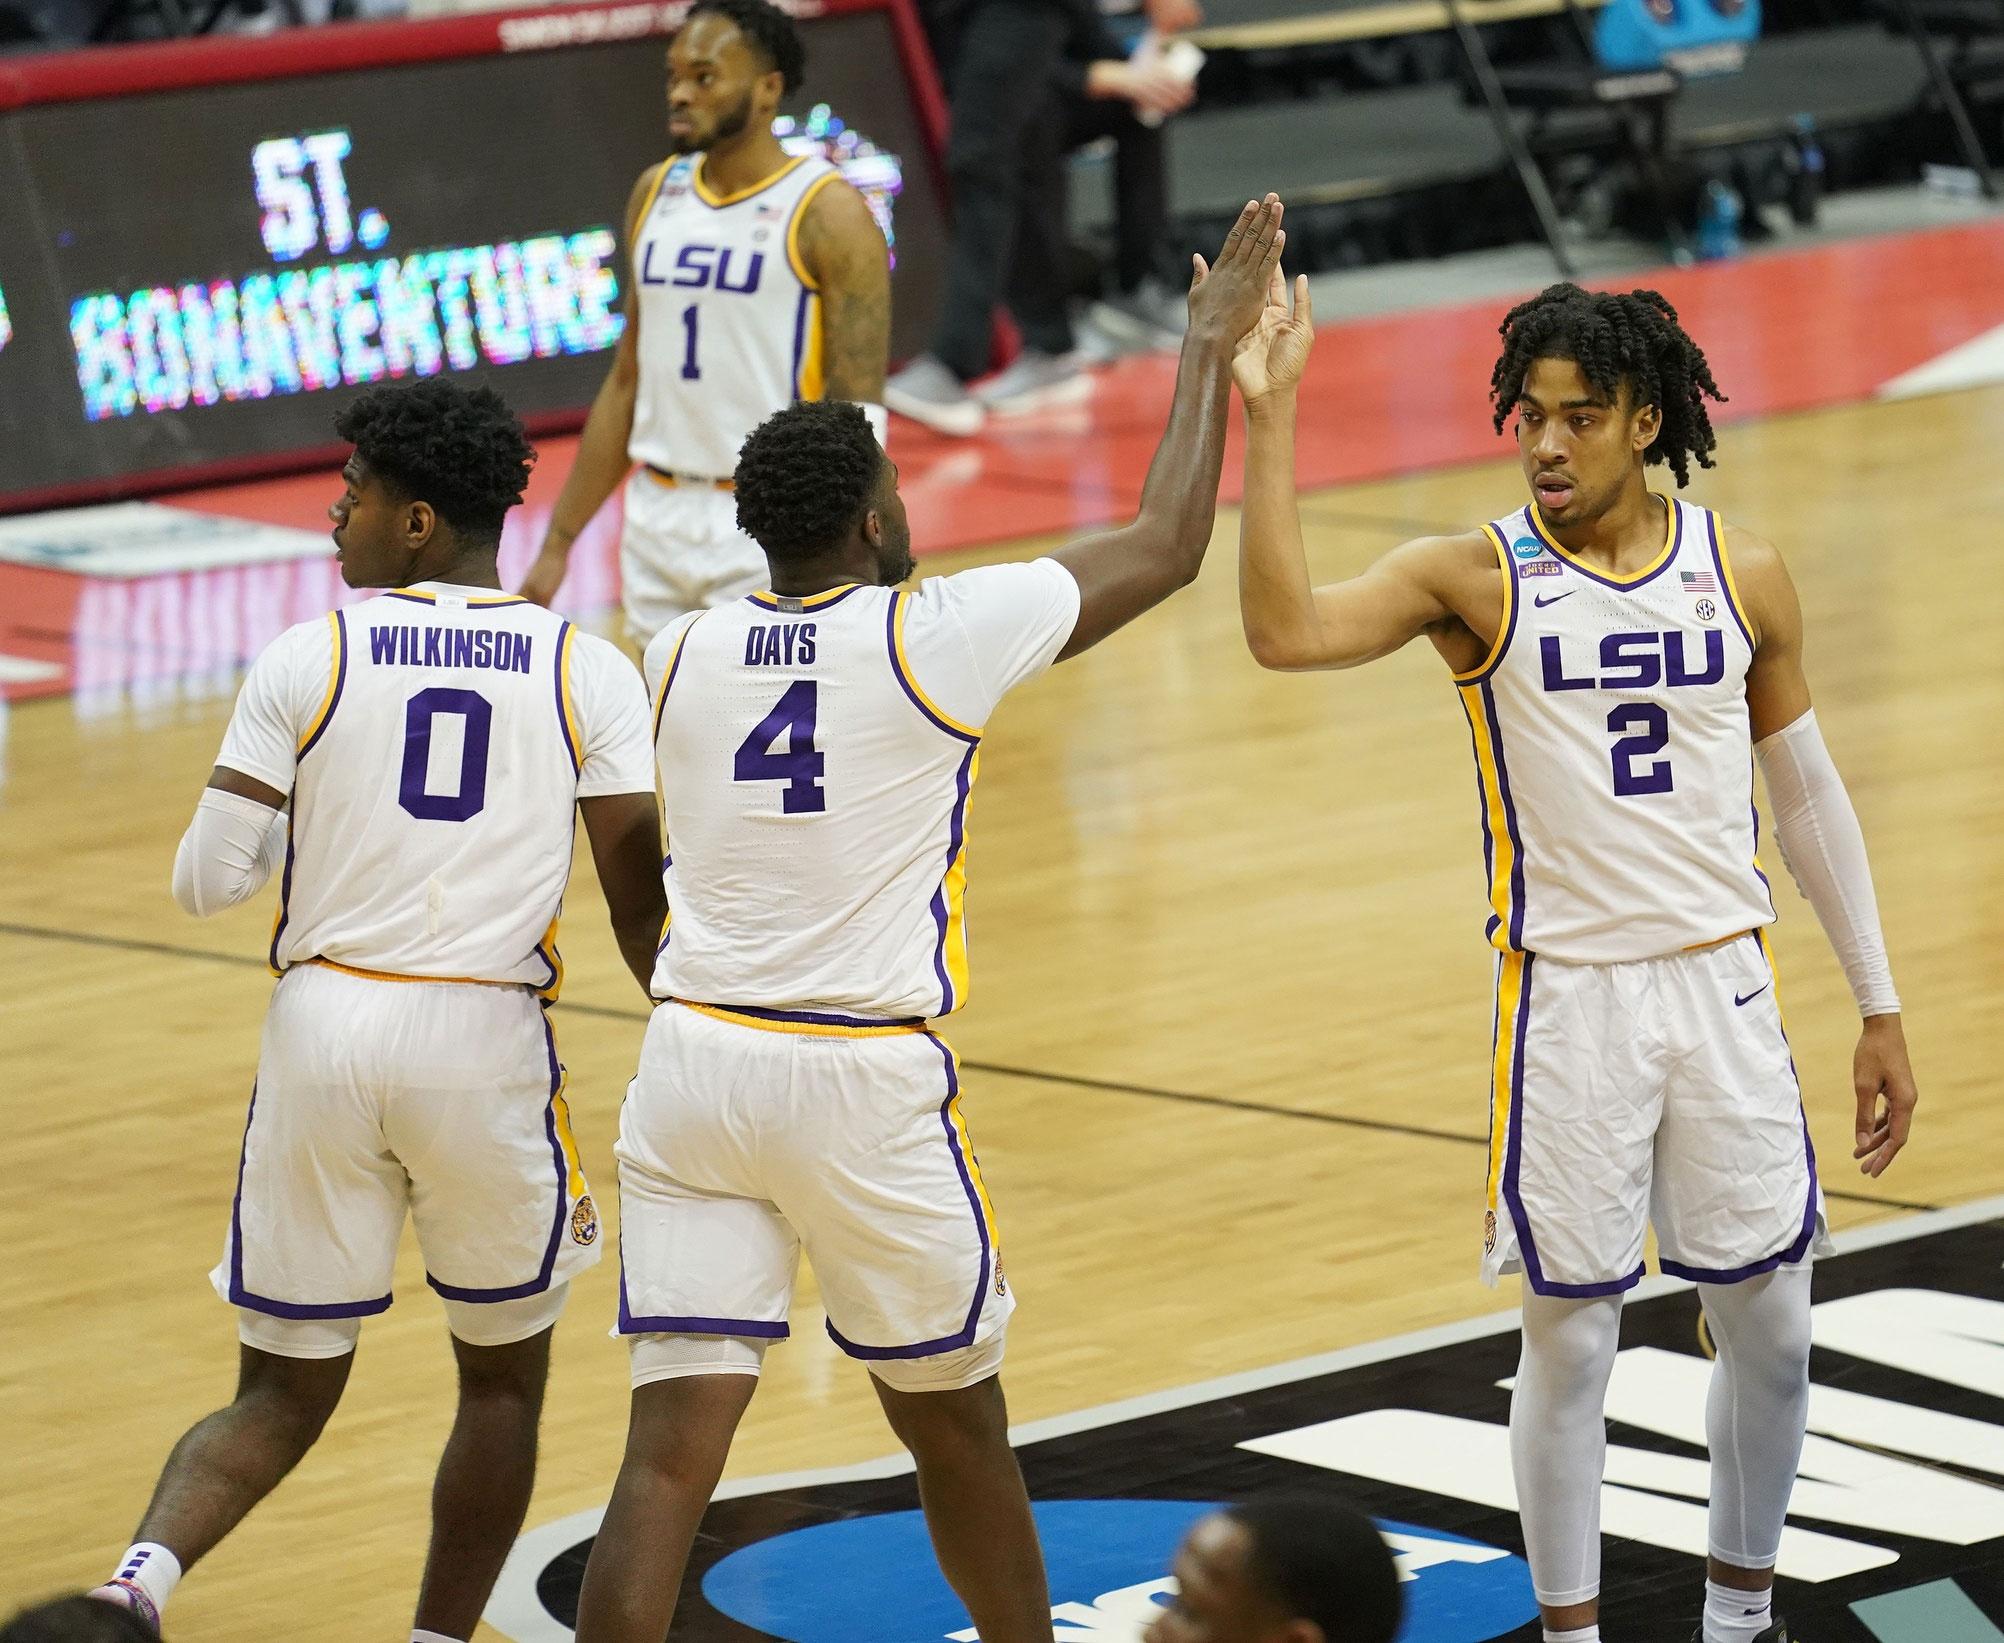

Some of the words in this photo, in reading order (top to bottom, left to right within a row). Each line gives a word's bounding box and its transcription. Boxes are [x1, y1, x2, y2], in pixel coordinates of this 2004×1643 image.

[252, 131, 390, 261] ST.
[642, 242, 764, 295] LSU
[70, 226, 627, 422] BONAVENTURE
[681, 303, 701, 380] 1
[1516, 545, 1541, 553] NCAA
[370, 626, 532, 674] WILKINSON
[744, 623, 817, 666] DAYS
[1539, 629, 1725, 692] LSU
[398, 687, 493, 822] 0
[733, 680, 826, 814] 4
[1606, 702, 1674, 796] 2
